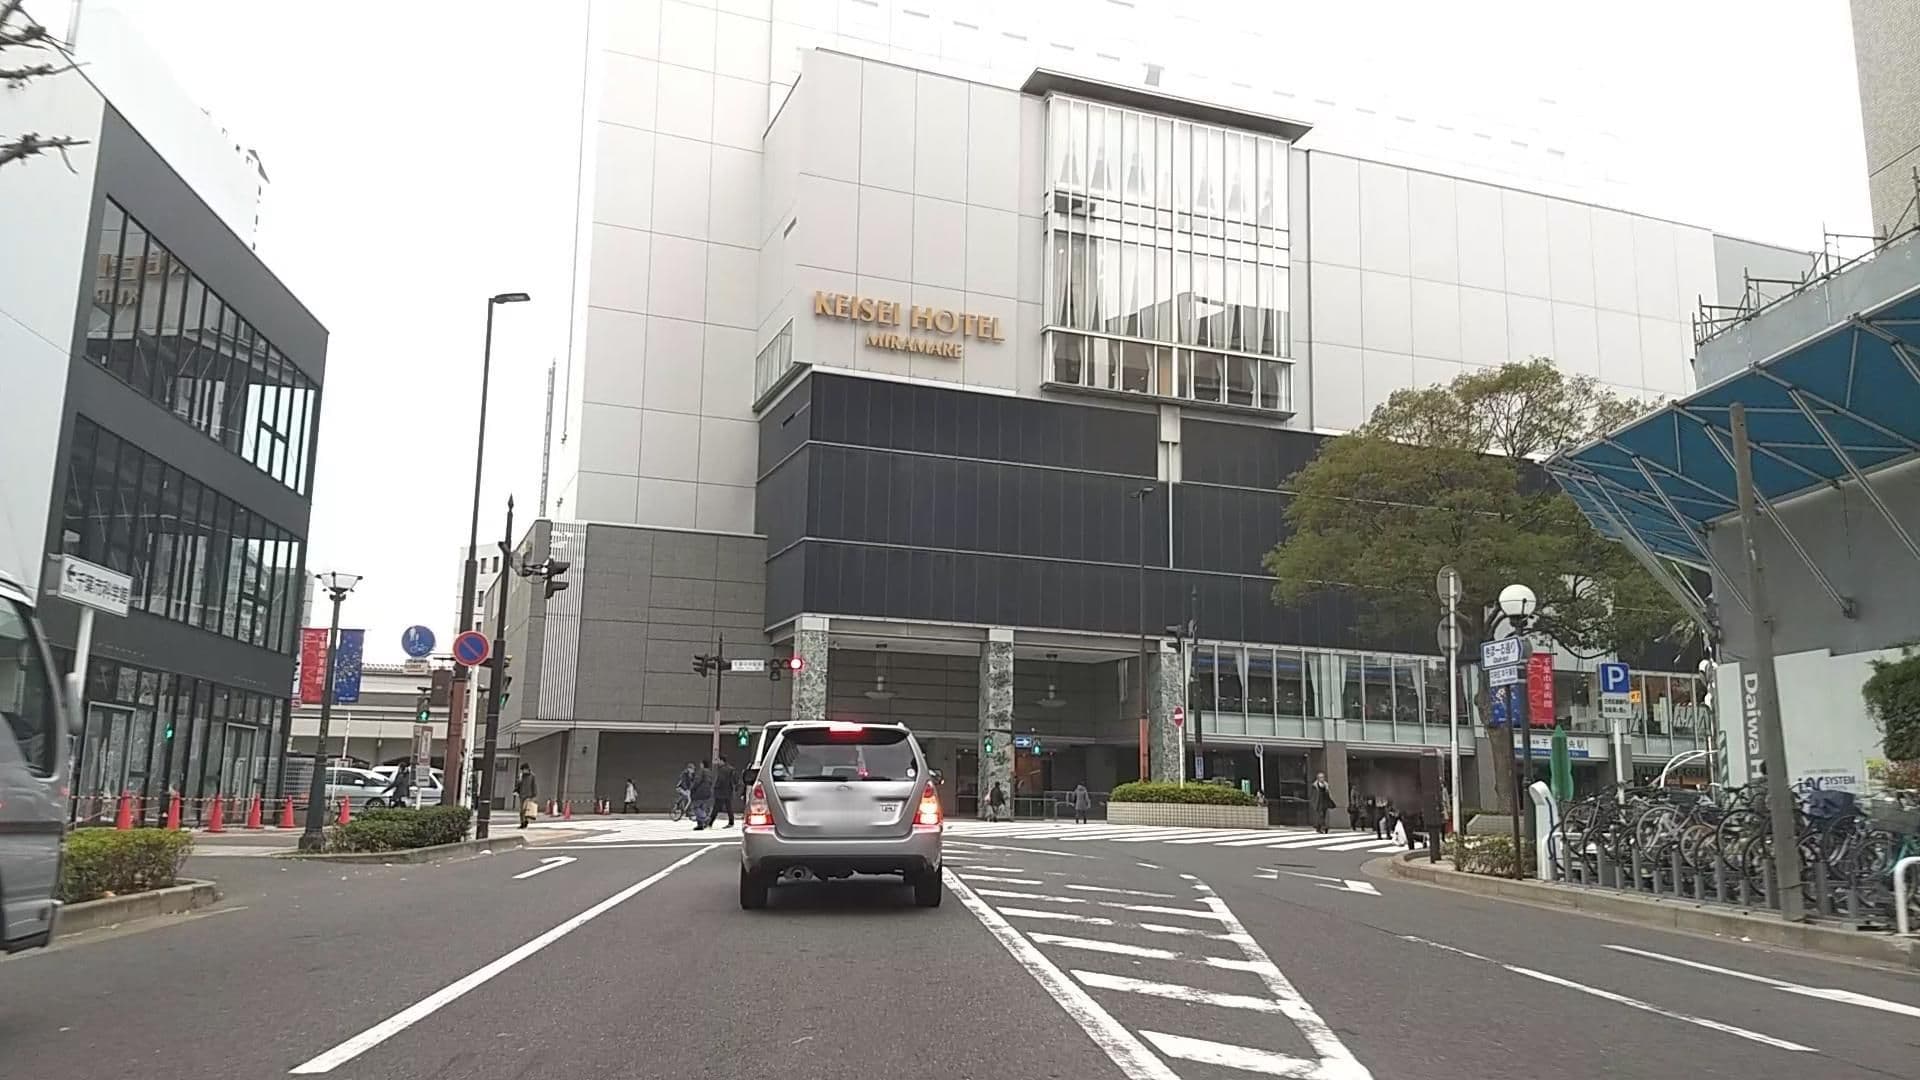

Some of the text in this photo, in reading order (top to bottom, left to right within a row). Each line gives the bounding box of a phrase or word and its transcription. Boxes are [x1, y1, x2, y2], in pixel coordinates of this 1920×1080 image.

[815, 290, 1005, 341] KEISEI HOTEL
[865, 331, 962, 359] MIRAMARE
[1607, 666, 1625, 690] P
[1744, 673, 1762, 755] Daiwa
